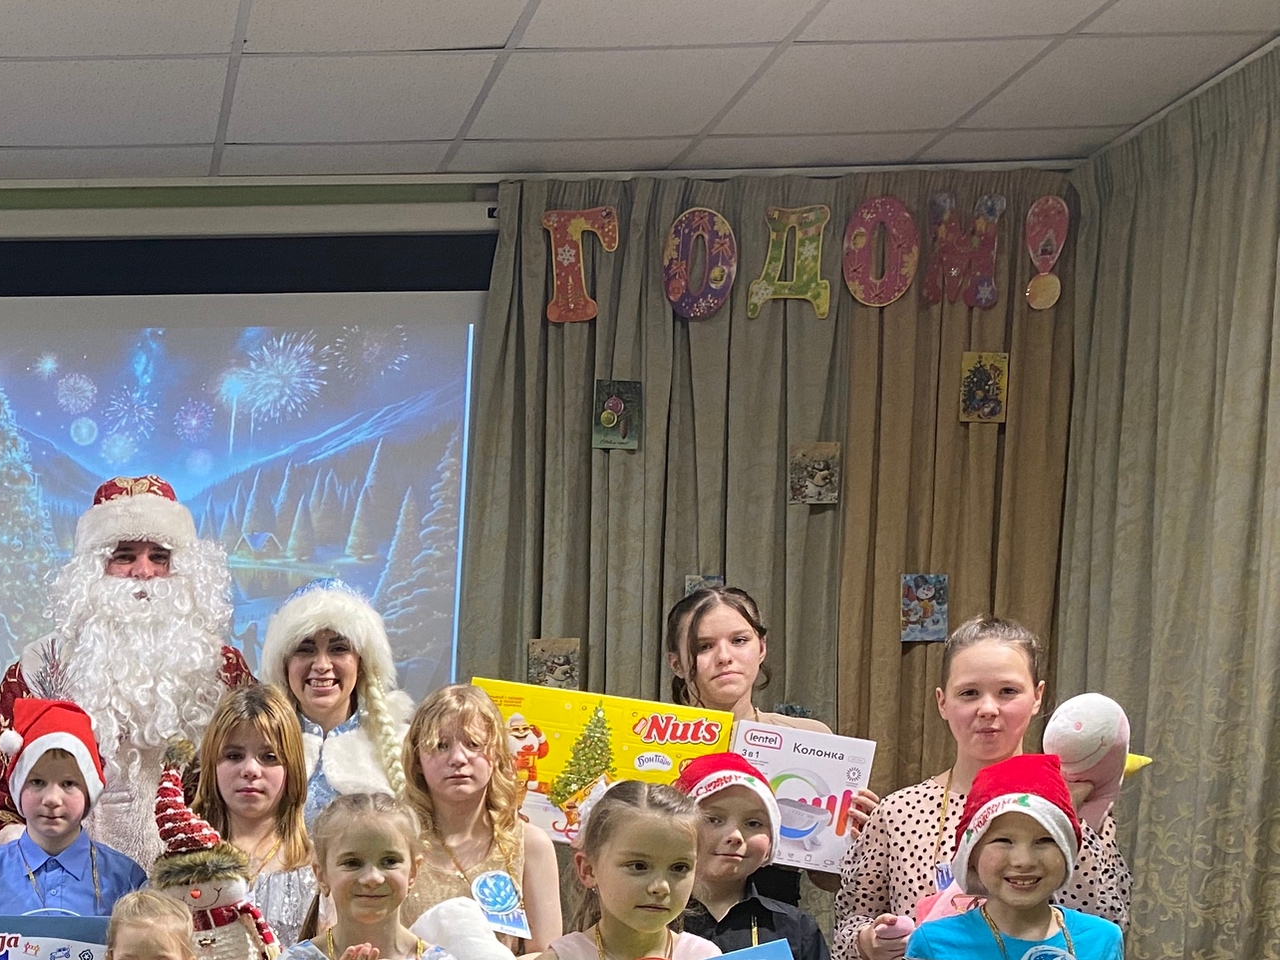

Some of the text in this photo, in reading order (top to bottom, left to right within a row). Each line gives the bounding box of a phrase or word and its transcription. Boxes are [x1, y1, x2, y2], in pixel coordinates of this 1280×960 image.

[642, 714, 720, 743] Nuts
[749, 732, 778, 745] lentel
[793, 742, 845, 760] Колонка
